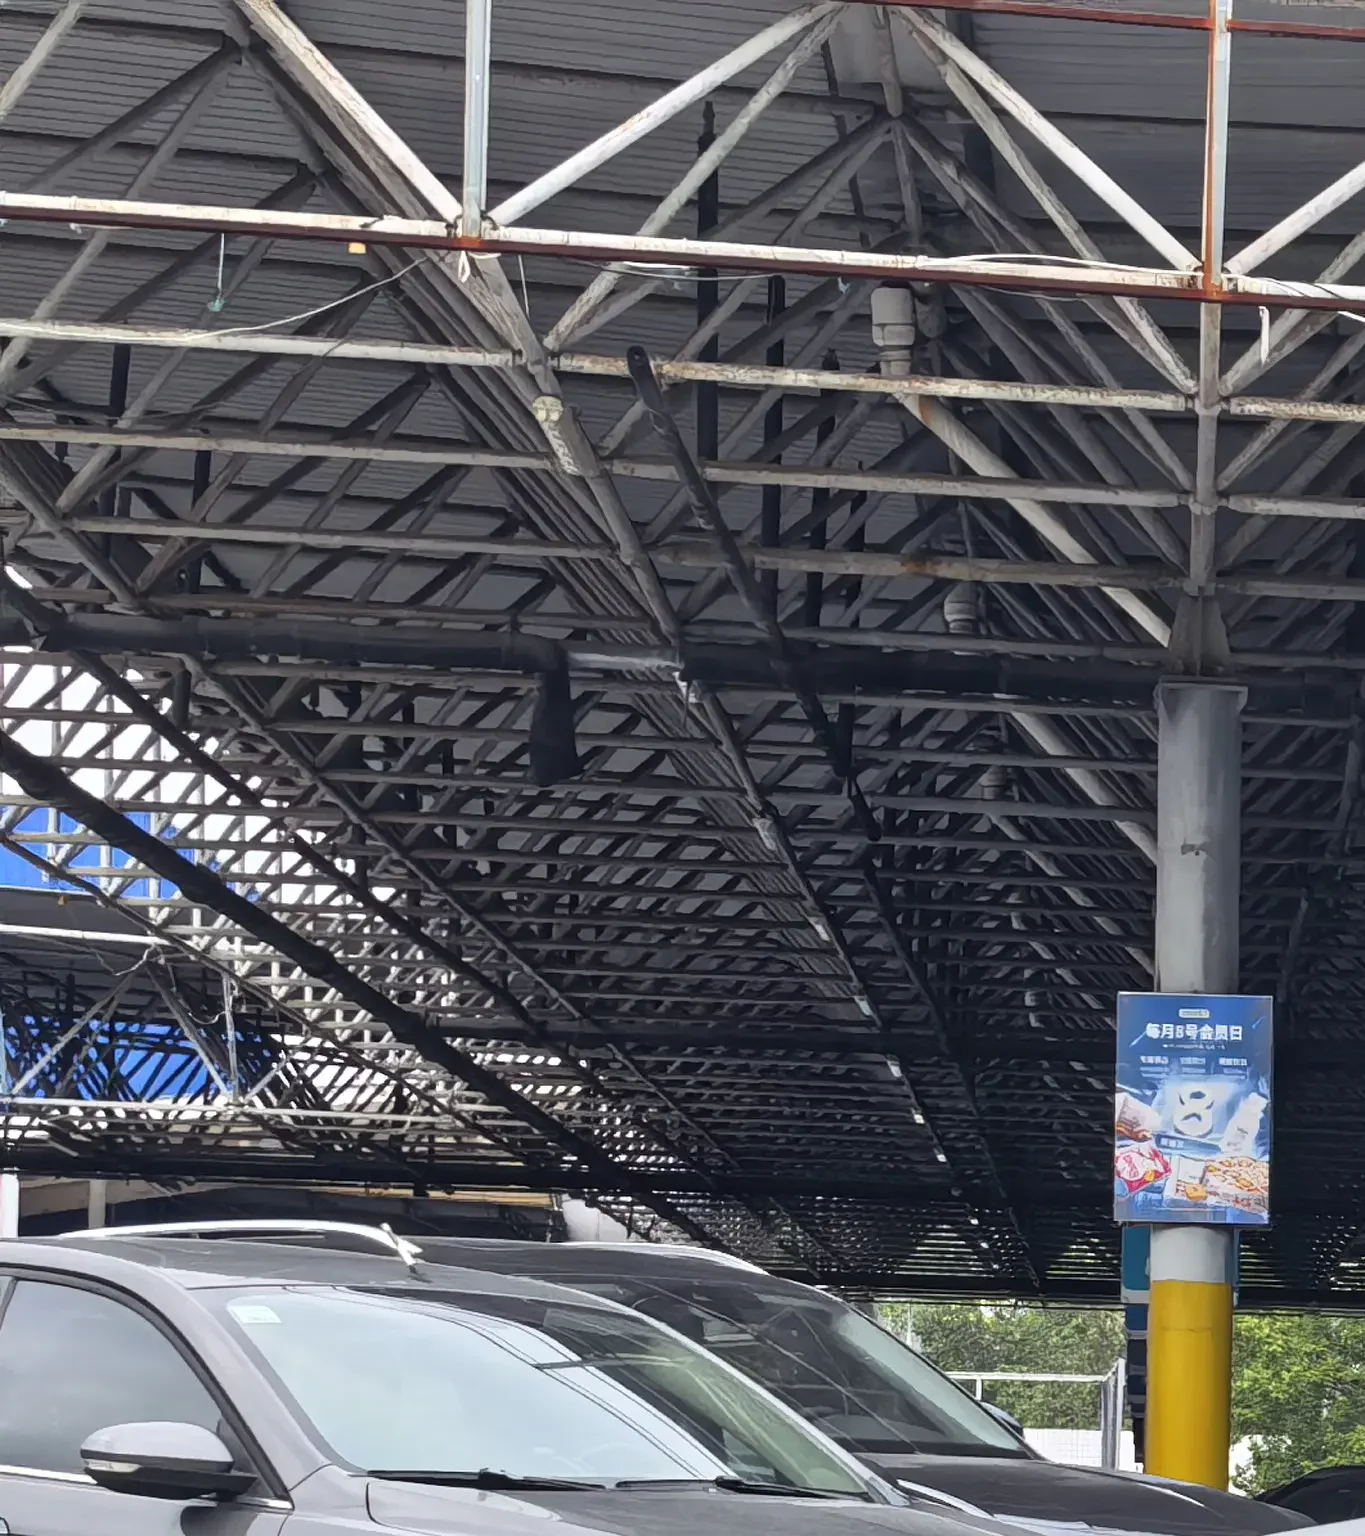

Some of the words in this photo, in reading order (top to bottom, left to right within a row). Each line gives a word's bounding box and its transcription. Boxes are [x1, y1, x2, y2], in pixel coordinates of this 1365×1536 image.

[1145, 1022, 1243, 1041] 每月8号会员日
